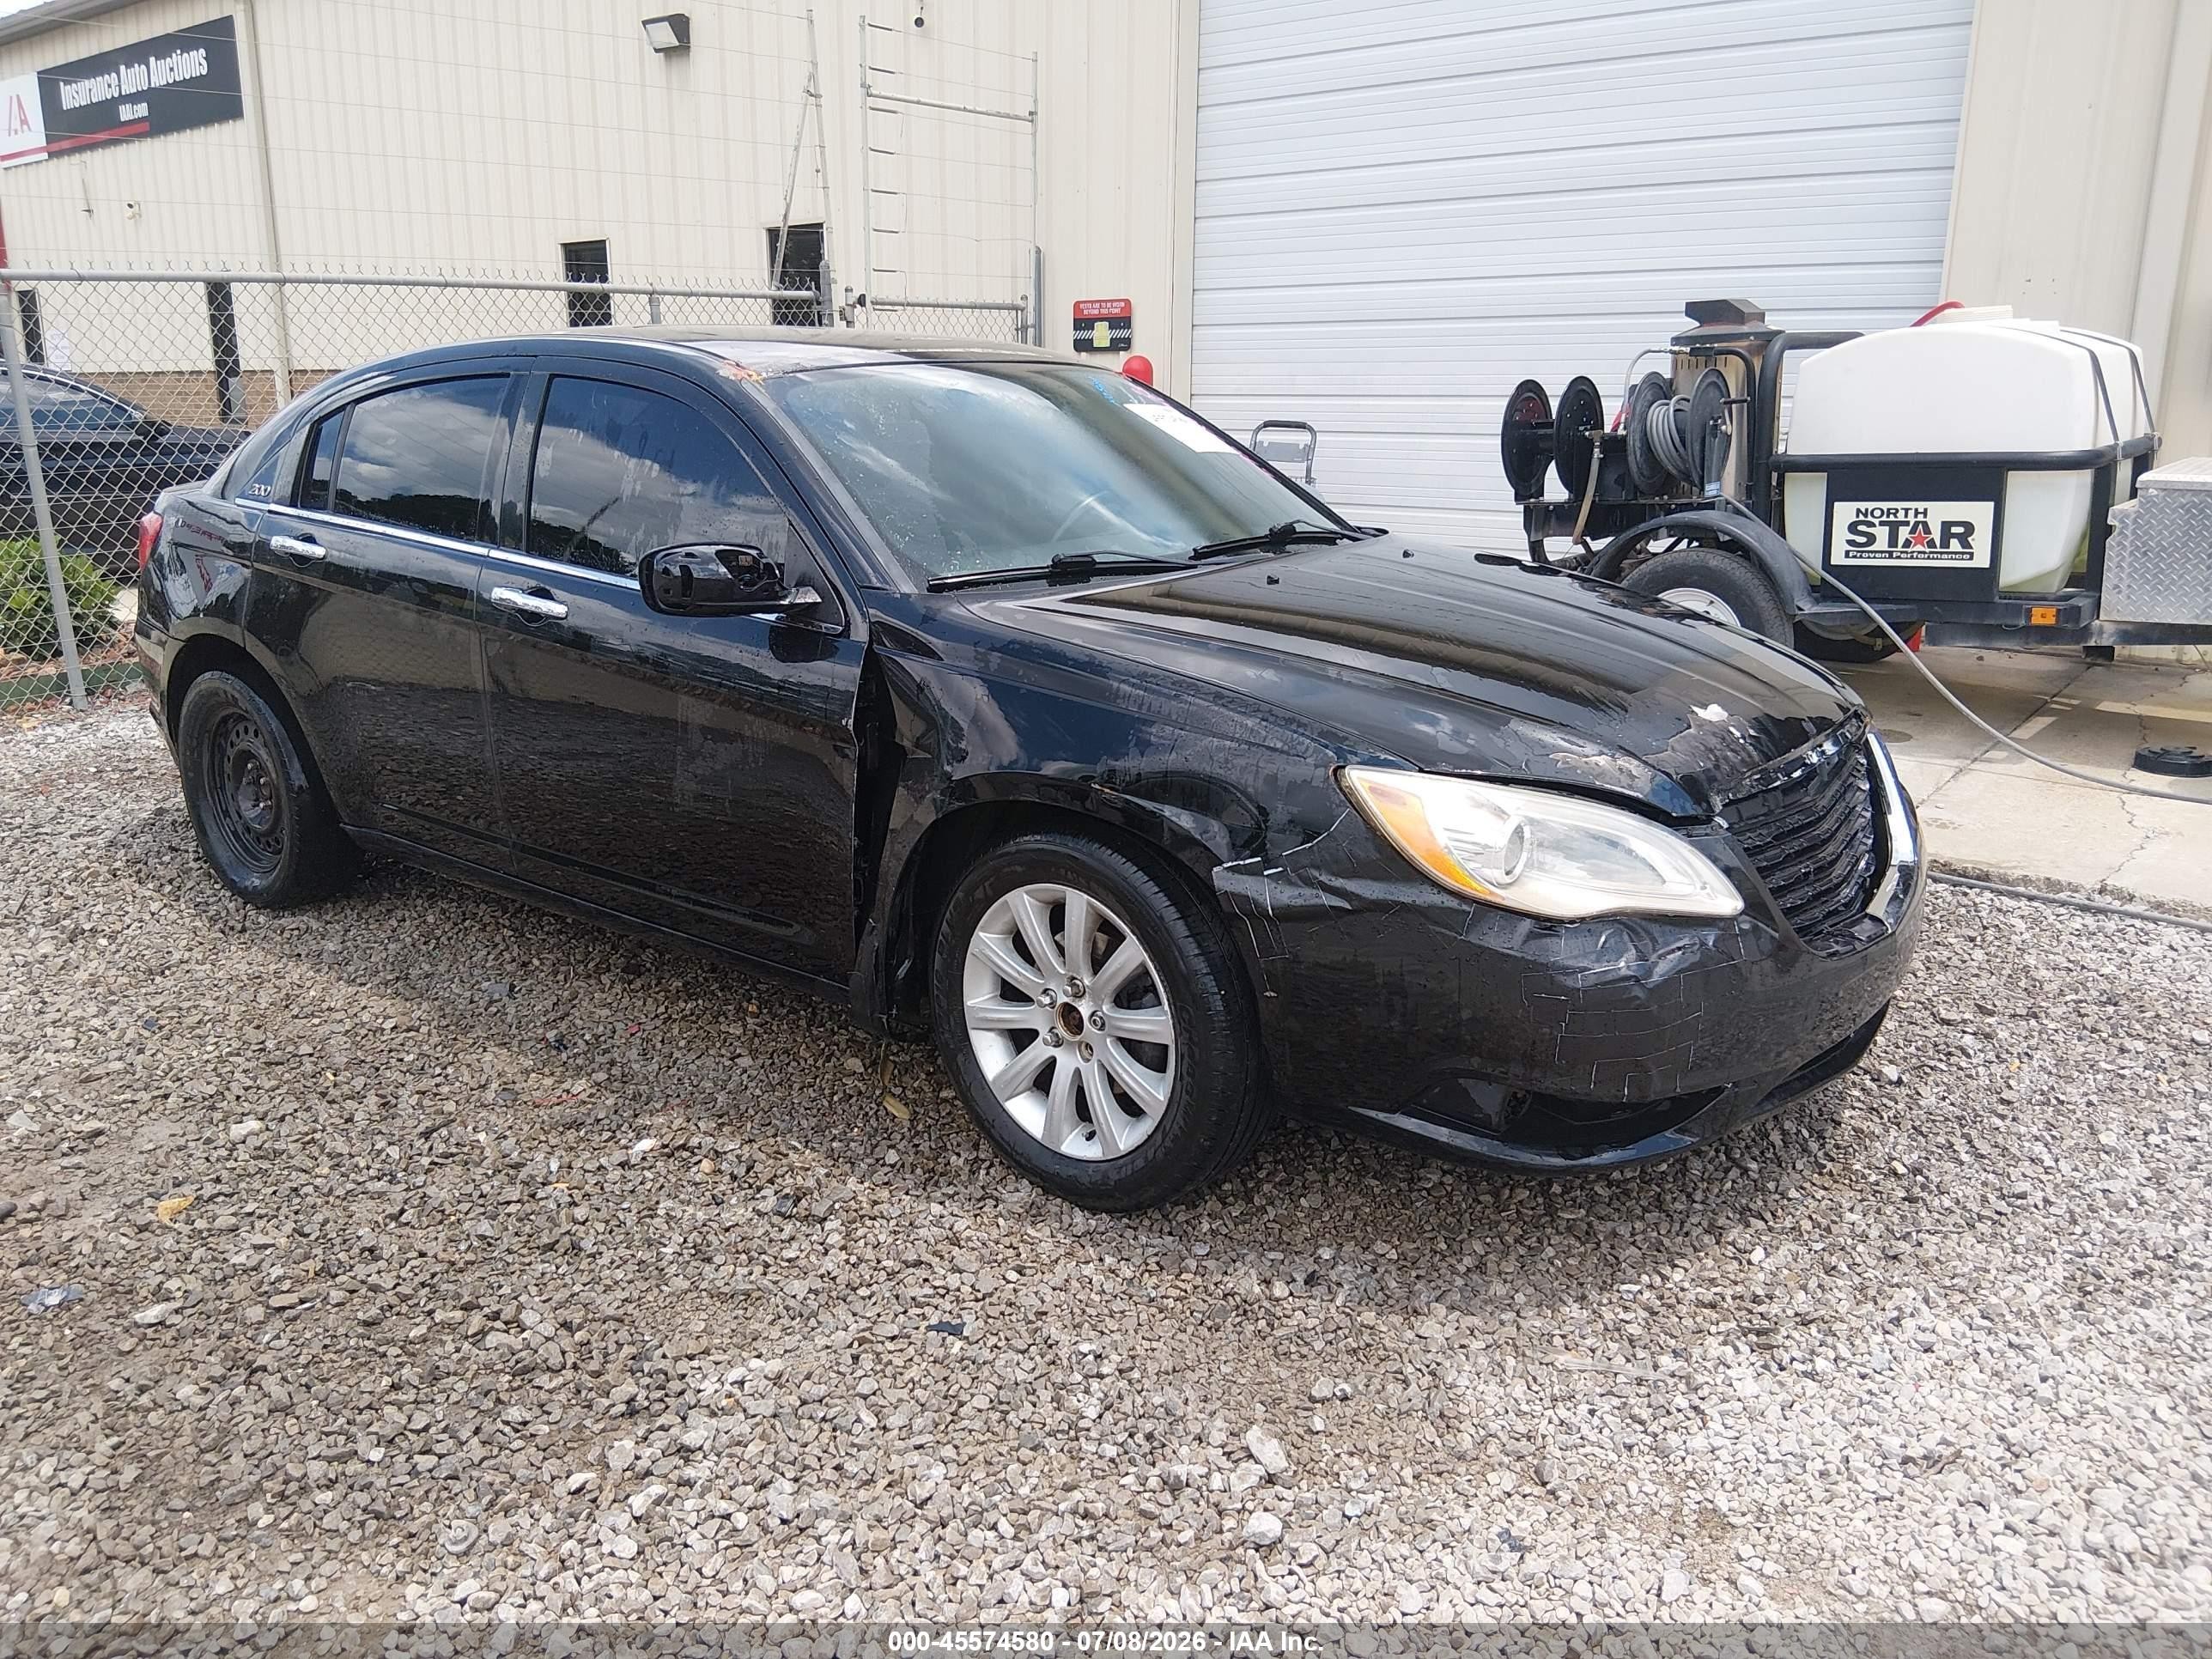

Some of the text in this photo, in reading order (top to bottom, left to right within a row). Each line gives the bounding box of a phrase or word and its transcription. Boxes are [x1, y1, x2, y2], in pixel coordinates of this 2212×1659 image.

[60, 48, 208, 110] Insurance Auto Auctions
[248, 483, 271, 497] 200
[1855, 507, 1929, 519] NORTH
[1845, 520, 1975, 550] STAR
[1892, 551, 1971, 560] Performance
